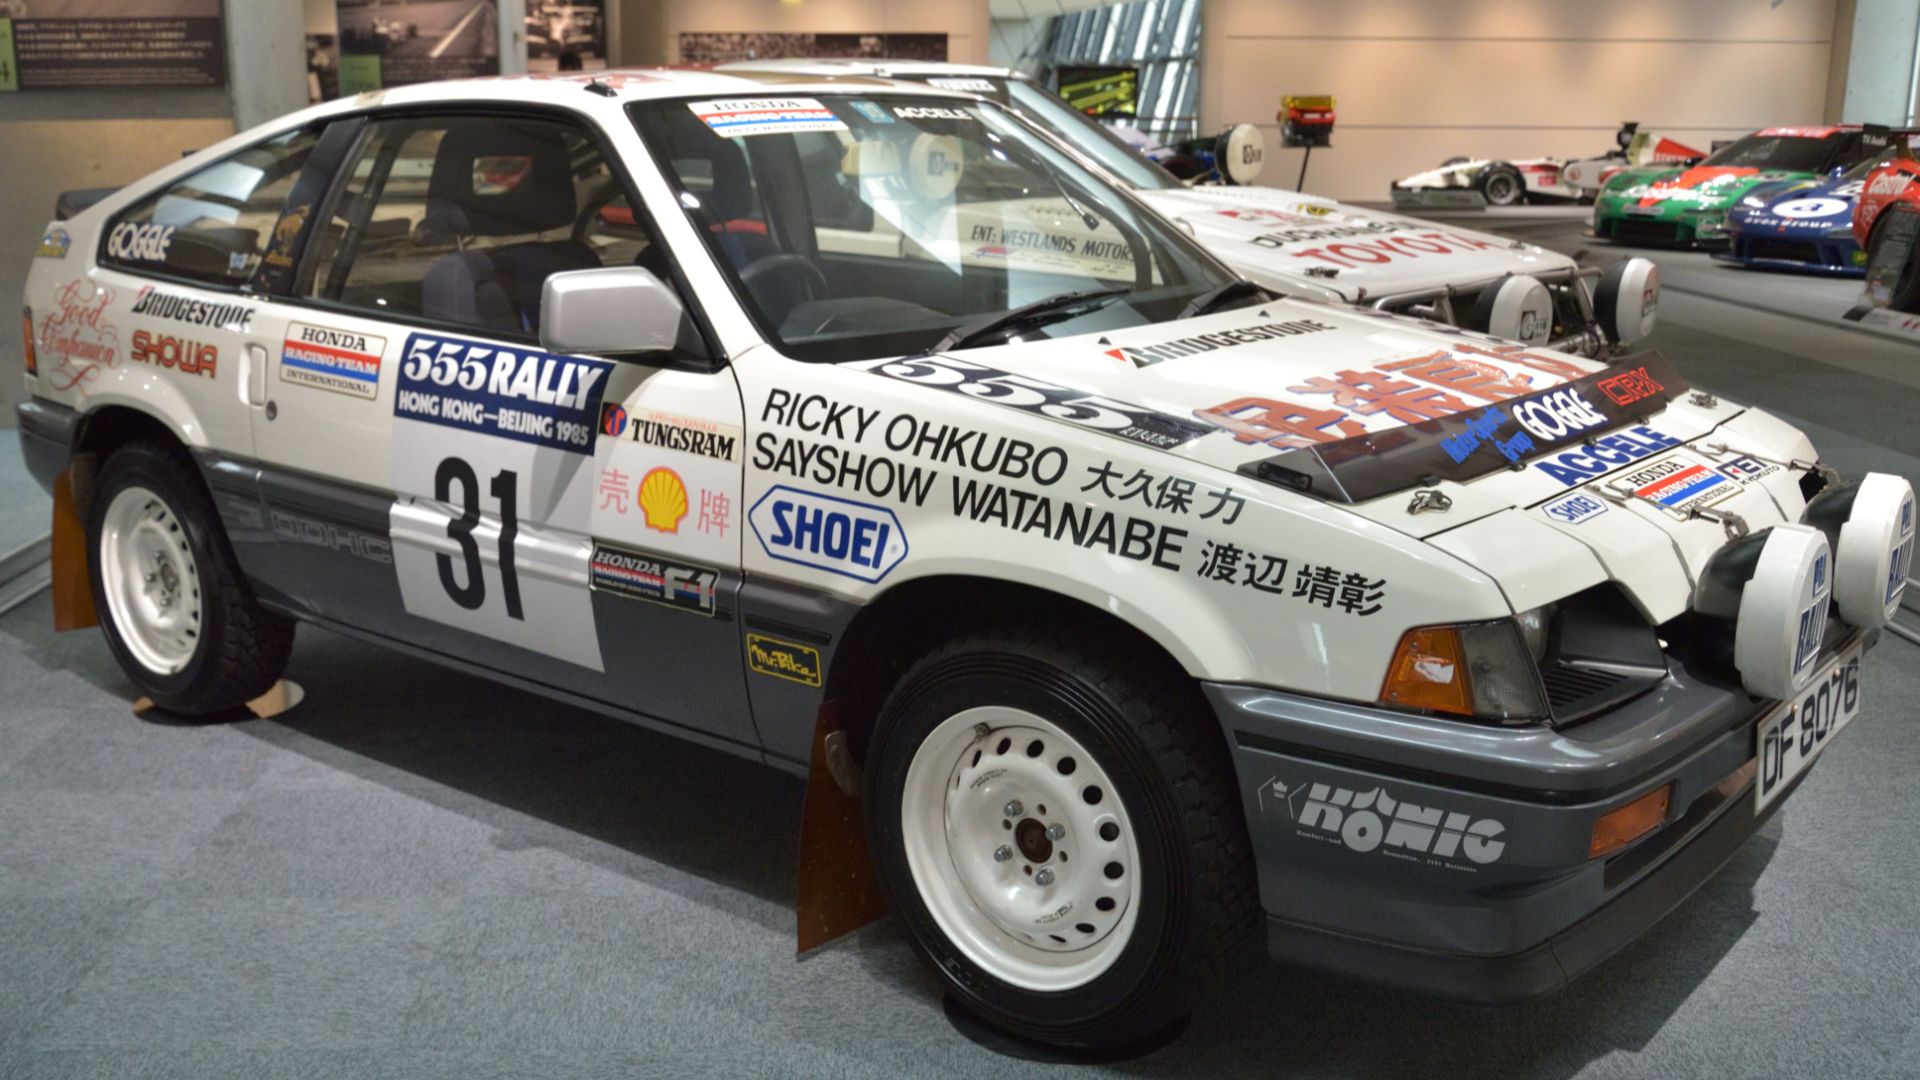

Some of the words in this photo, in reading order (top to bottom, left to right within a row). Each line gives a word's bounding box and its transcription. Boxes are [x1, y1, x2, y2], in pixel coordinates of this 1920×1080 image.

[713, 101, 801, 111] HONDA
[893, 106, 973, 120] ACCELE
[108, 222, 174, 261] GOGGLE
[971, 224, 997, 244] ENT:
[1001, 228, 1077, 253] WESTLANDS
[1292, 233, 1491, 268] TOYOTA
[132, 285, 254, 328] BRIDGESTONE
[131, 330, 218, 379] SHOWA
[301, 327, 367, 352] HONDA
[1104, 319, 1337, 368] BRIDGESTONE
[286, 369, 371, 394] INTERNATIONAL
[488, 352, 605, 410] RALLY
[398, 390, 440, 417] HONG
[556, 420, 590, 446] 1985
[1511, 386, 1609, 441] GOGGLE
[631, 417, 736, 461] TUNGSRAM
[760, 388, 881, 444] RICKY
[885, 413, 1069, 487] OHKUBO
[1080, 460, 1198, 515] 大久保
[1199, 487, 1247, 526] 力
[1534, 426, 1683, 487] ACCELE
[1625, 460, 1686, 488] HONDA
[1739, 464, 1781, 486] KYOKUTO
[752, 432, 938, 507] SAYSHOW
[951, 475, 1189, 573] WATANABE
[1197, 538, 1290, 595] 渡辺
[1292, 563, 1387, 617] 靖彰
[1551, 496, 1602, 521] SHOEI
[270, 511, 394, 564] DOHC
[434, 456, 524, 621] 31
[771, 500, 891, 571] SHOEI
[595, 551, 661, 577] HONDA
[663, 566, 715, 608] F1
[1762, 712, 1796, 797] DF
[1800, 655, 1859, 758] 8076
